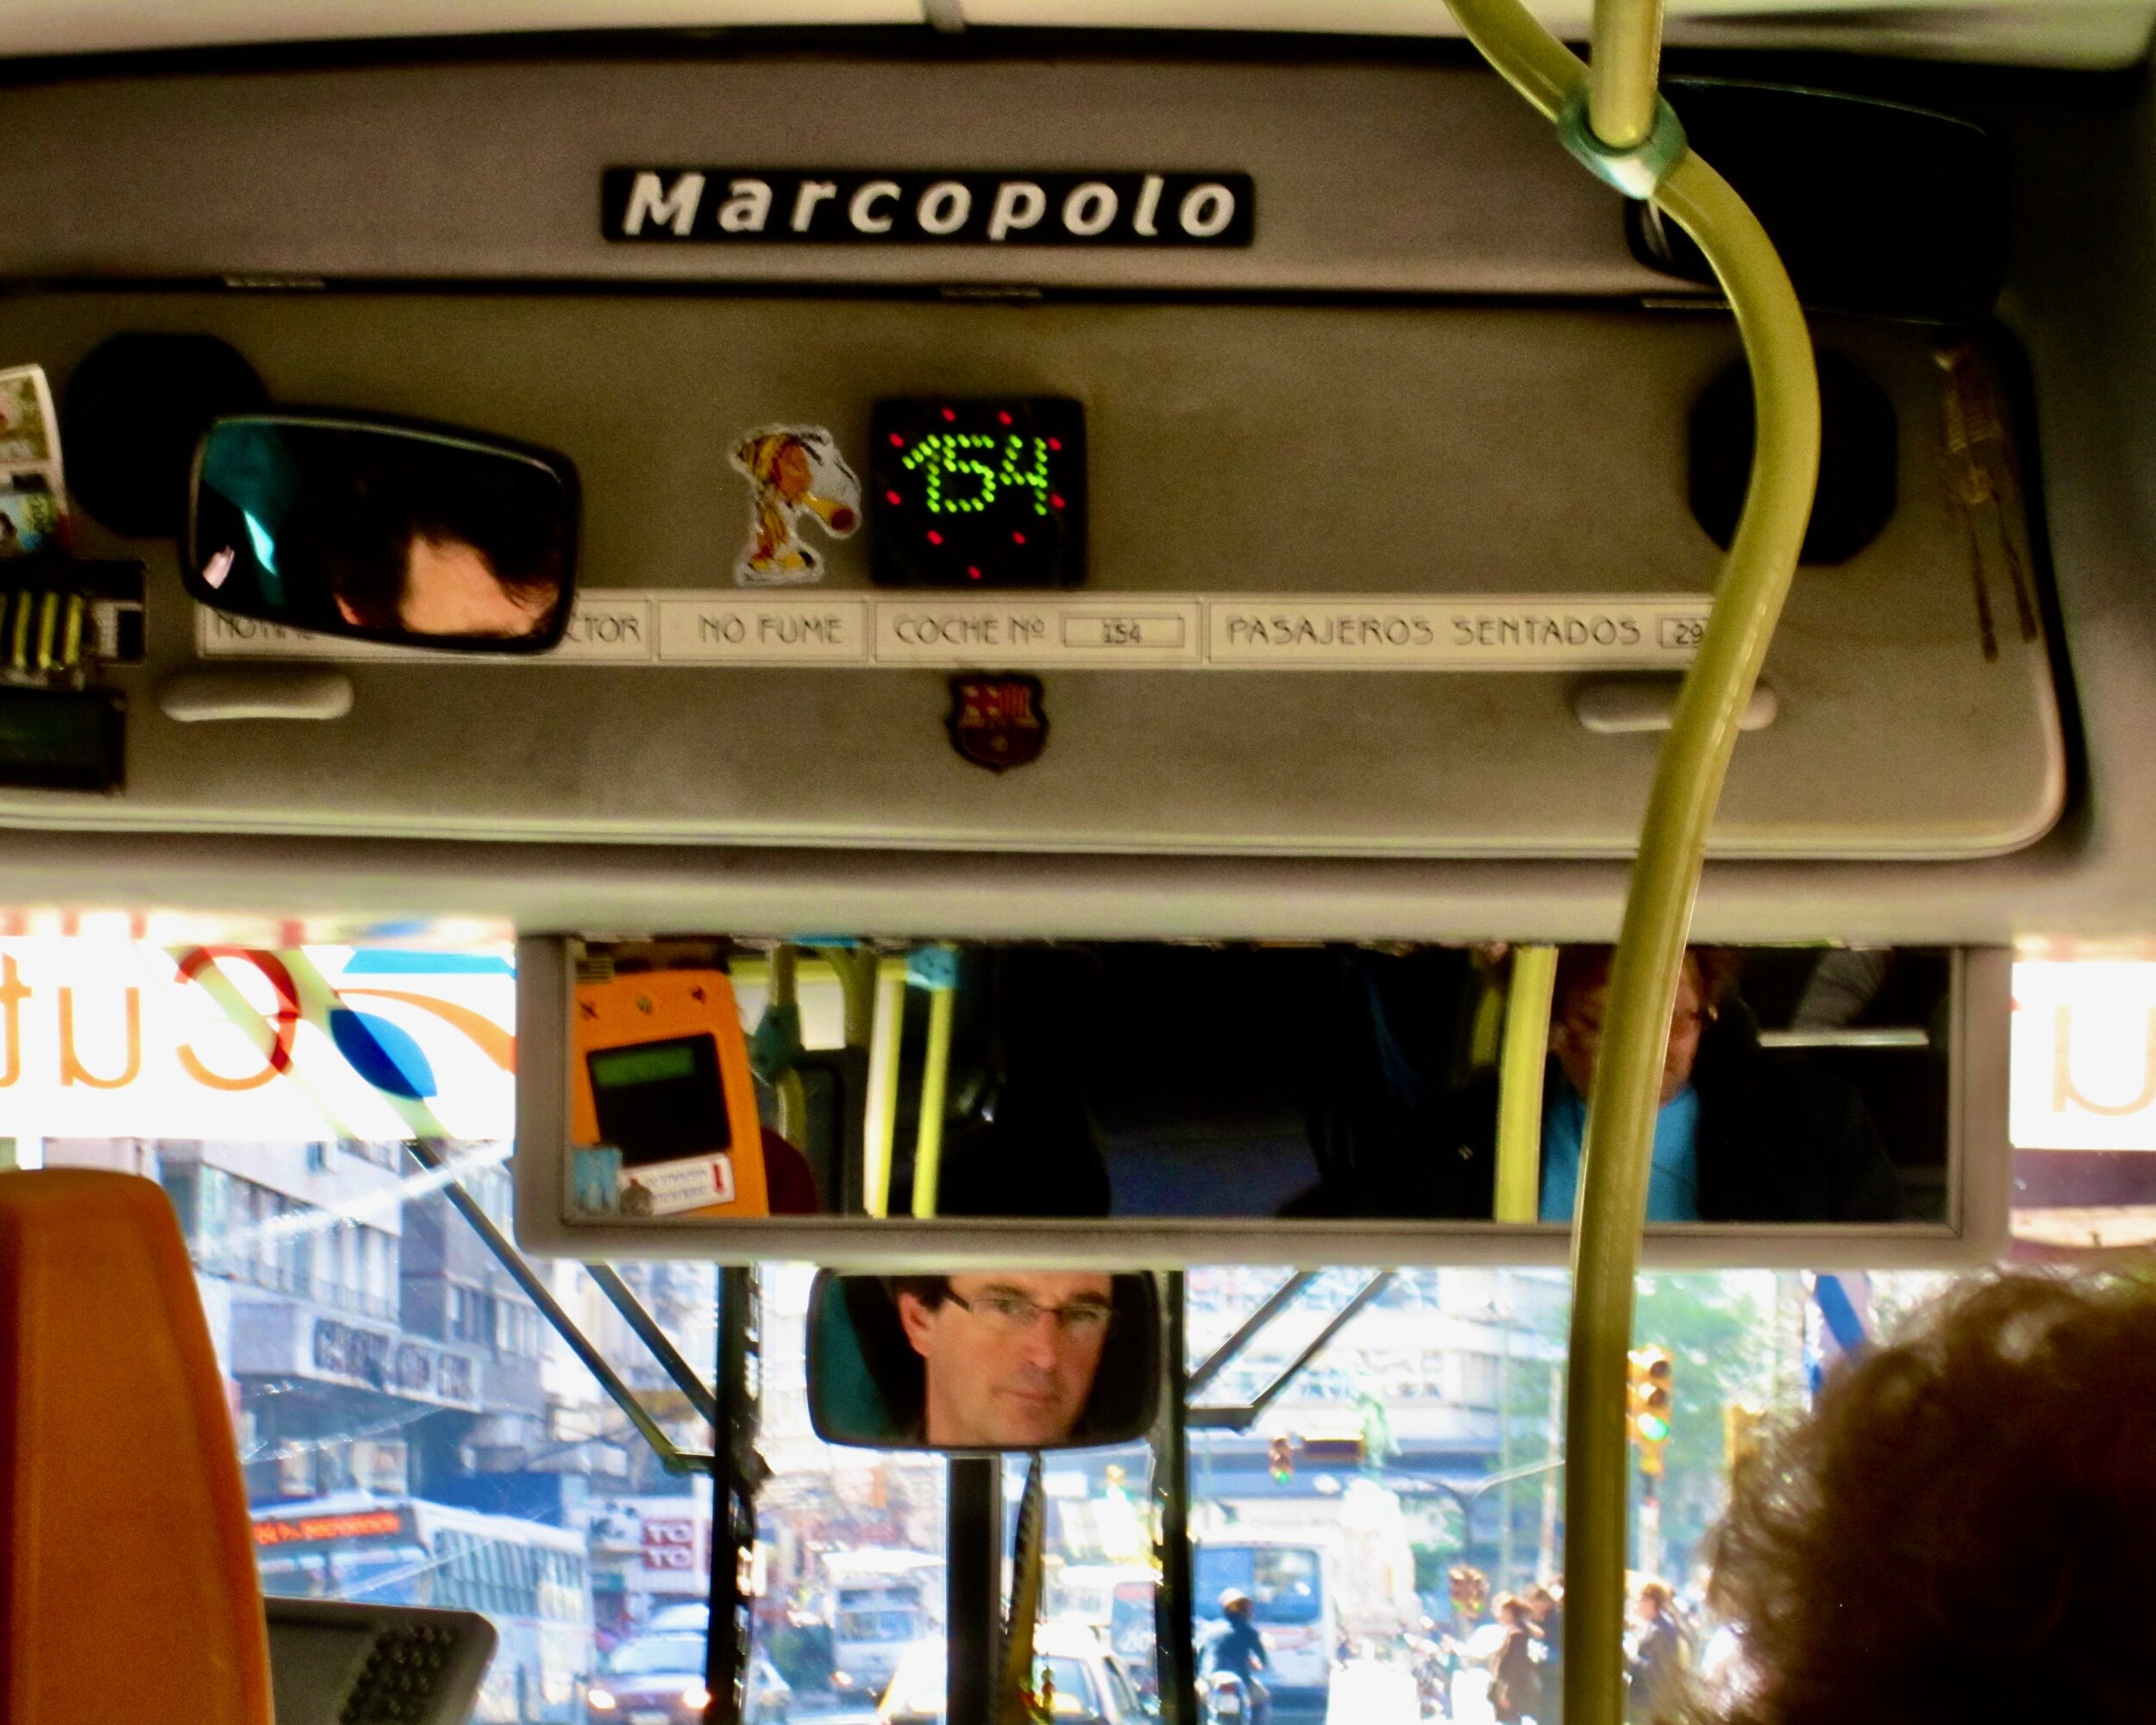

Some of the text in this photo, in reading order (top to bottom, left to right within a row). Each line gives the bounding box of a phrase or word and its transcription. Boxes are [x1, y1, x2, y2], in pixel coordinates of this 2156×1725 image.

[624, 172, 1236, 242] Marcopolo
[901, 433, 1048, 516] 154
[699, 613, 843, 644] NO FUME
[893, 614, 1000, 645] COCHE
[1103, 621, 1142, 644] 154
[1225, 613, 1434, 646] PASAJEROS
[1451, 613, 1642, 646] SENTADOS
